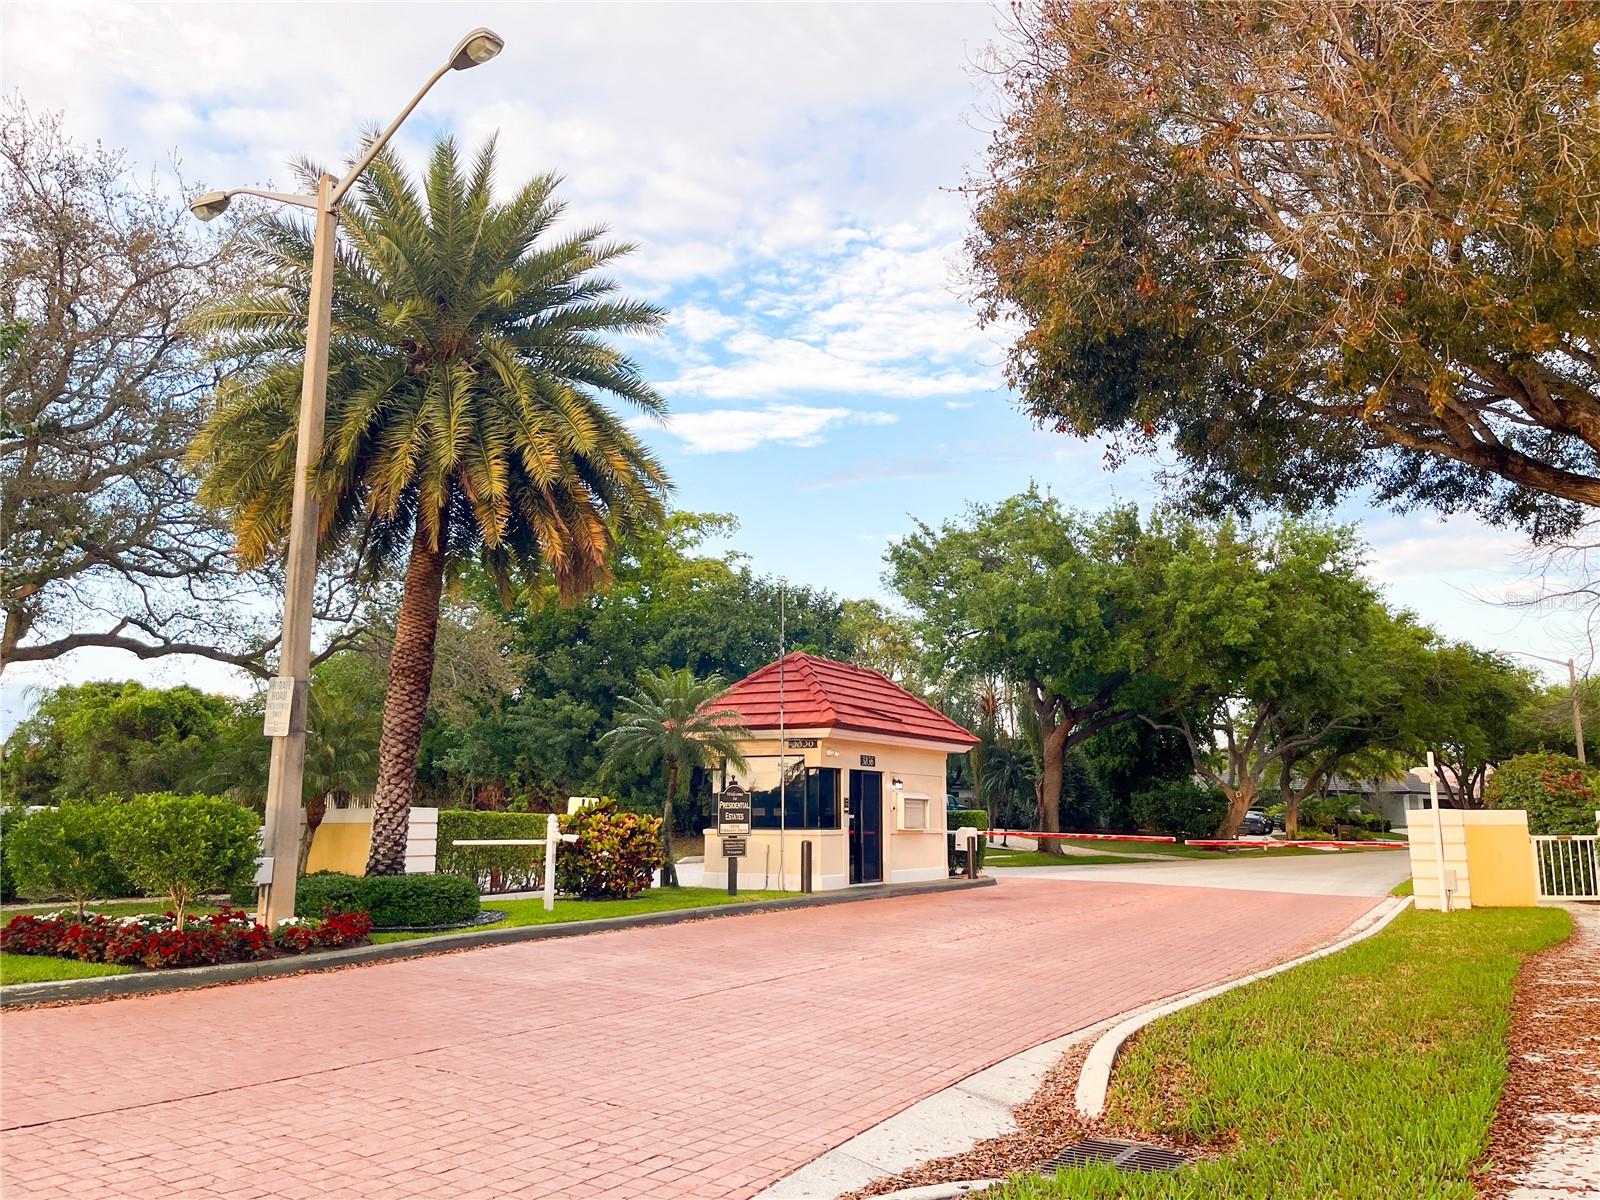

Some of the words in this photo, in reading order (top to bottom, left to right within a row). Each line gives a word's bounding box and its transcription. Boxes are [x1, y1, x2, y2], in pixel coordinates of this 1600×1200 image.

[271, 691, 287, 700] ROAD
[719, 801, 750, 809] PRESIDENTIAL
[725, 812, 744, 820] ESTATES
